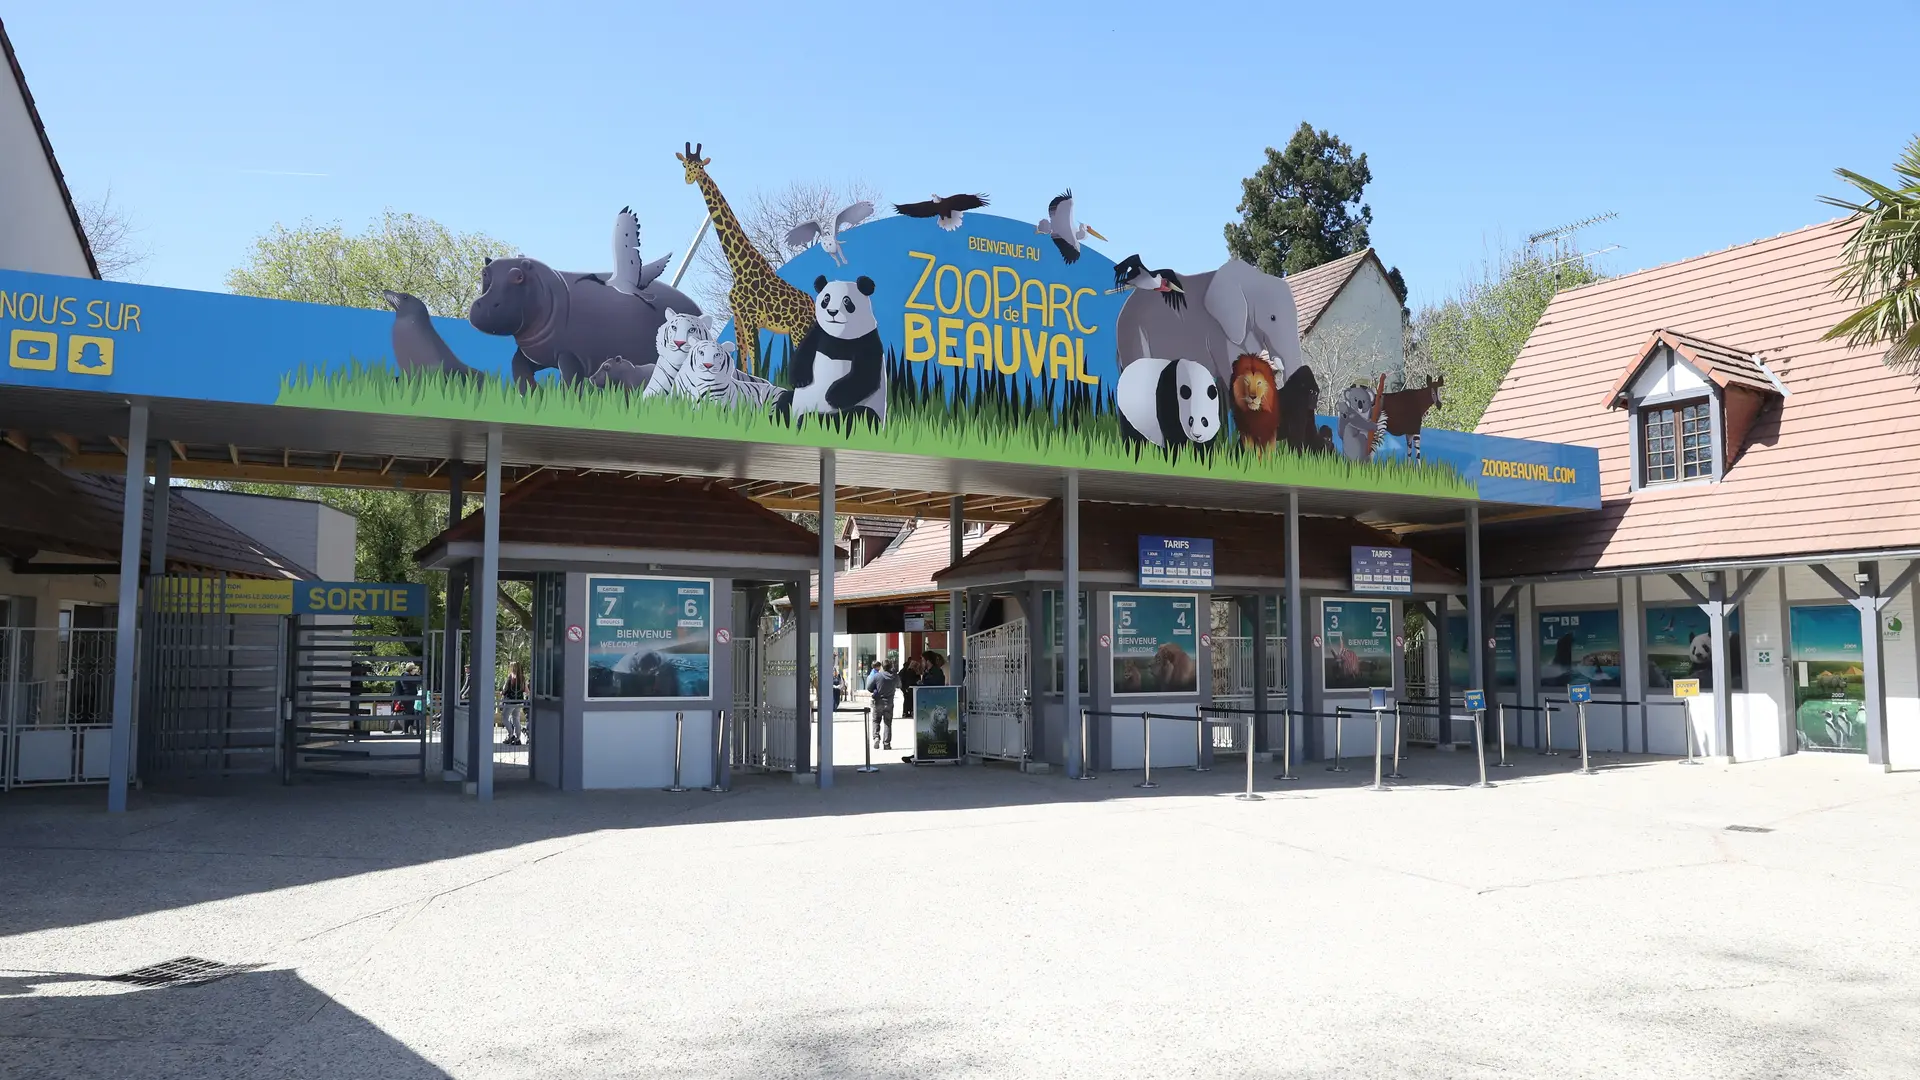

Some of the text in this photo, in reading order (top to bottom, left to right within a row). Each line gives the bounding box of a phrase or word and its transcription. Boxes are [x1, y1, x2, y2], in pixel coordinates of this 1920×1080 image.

[968, 236, 1041, 261] BIENVENUE AU
[0, 290, 141, 333] NOUS SUR
[1003, 305, 1019, 322] de
[904, 312, 1099, 385] BEAUVAL
[1482, 458, 1576, 484] ZOOBEAUVAL.COM
[1164, 540, 1190, 549] TARIFS
[1371, 550, 1392, 558] TARIFS
[309, 587, 408, 611] SORTIE
[604, 597, 617, 615] 7
[684, 599, 698, 617] 6
[1122, 611, 1131, 626] 5
[1177, 612, 1186, 626] 4
[1331, 615, 1338, 629] 3
[1375, 616, 1383, 629] 2
[616, 629, 672, 639] BIENVENUE
[1548, 625, 1554, 637] 1
[1118, 637, 1157, 645] BIENVENUE
